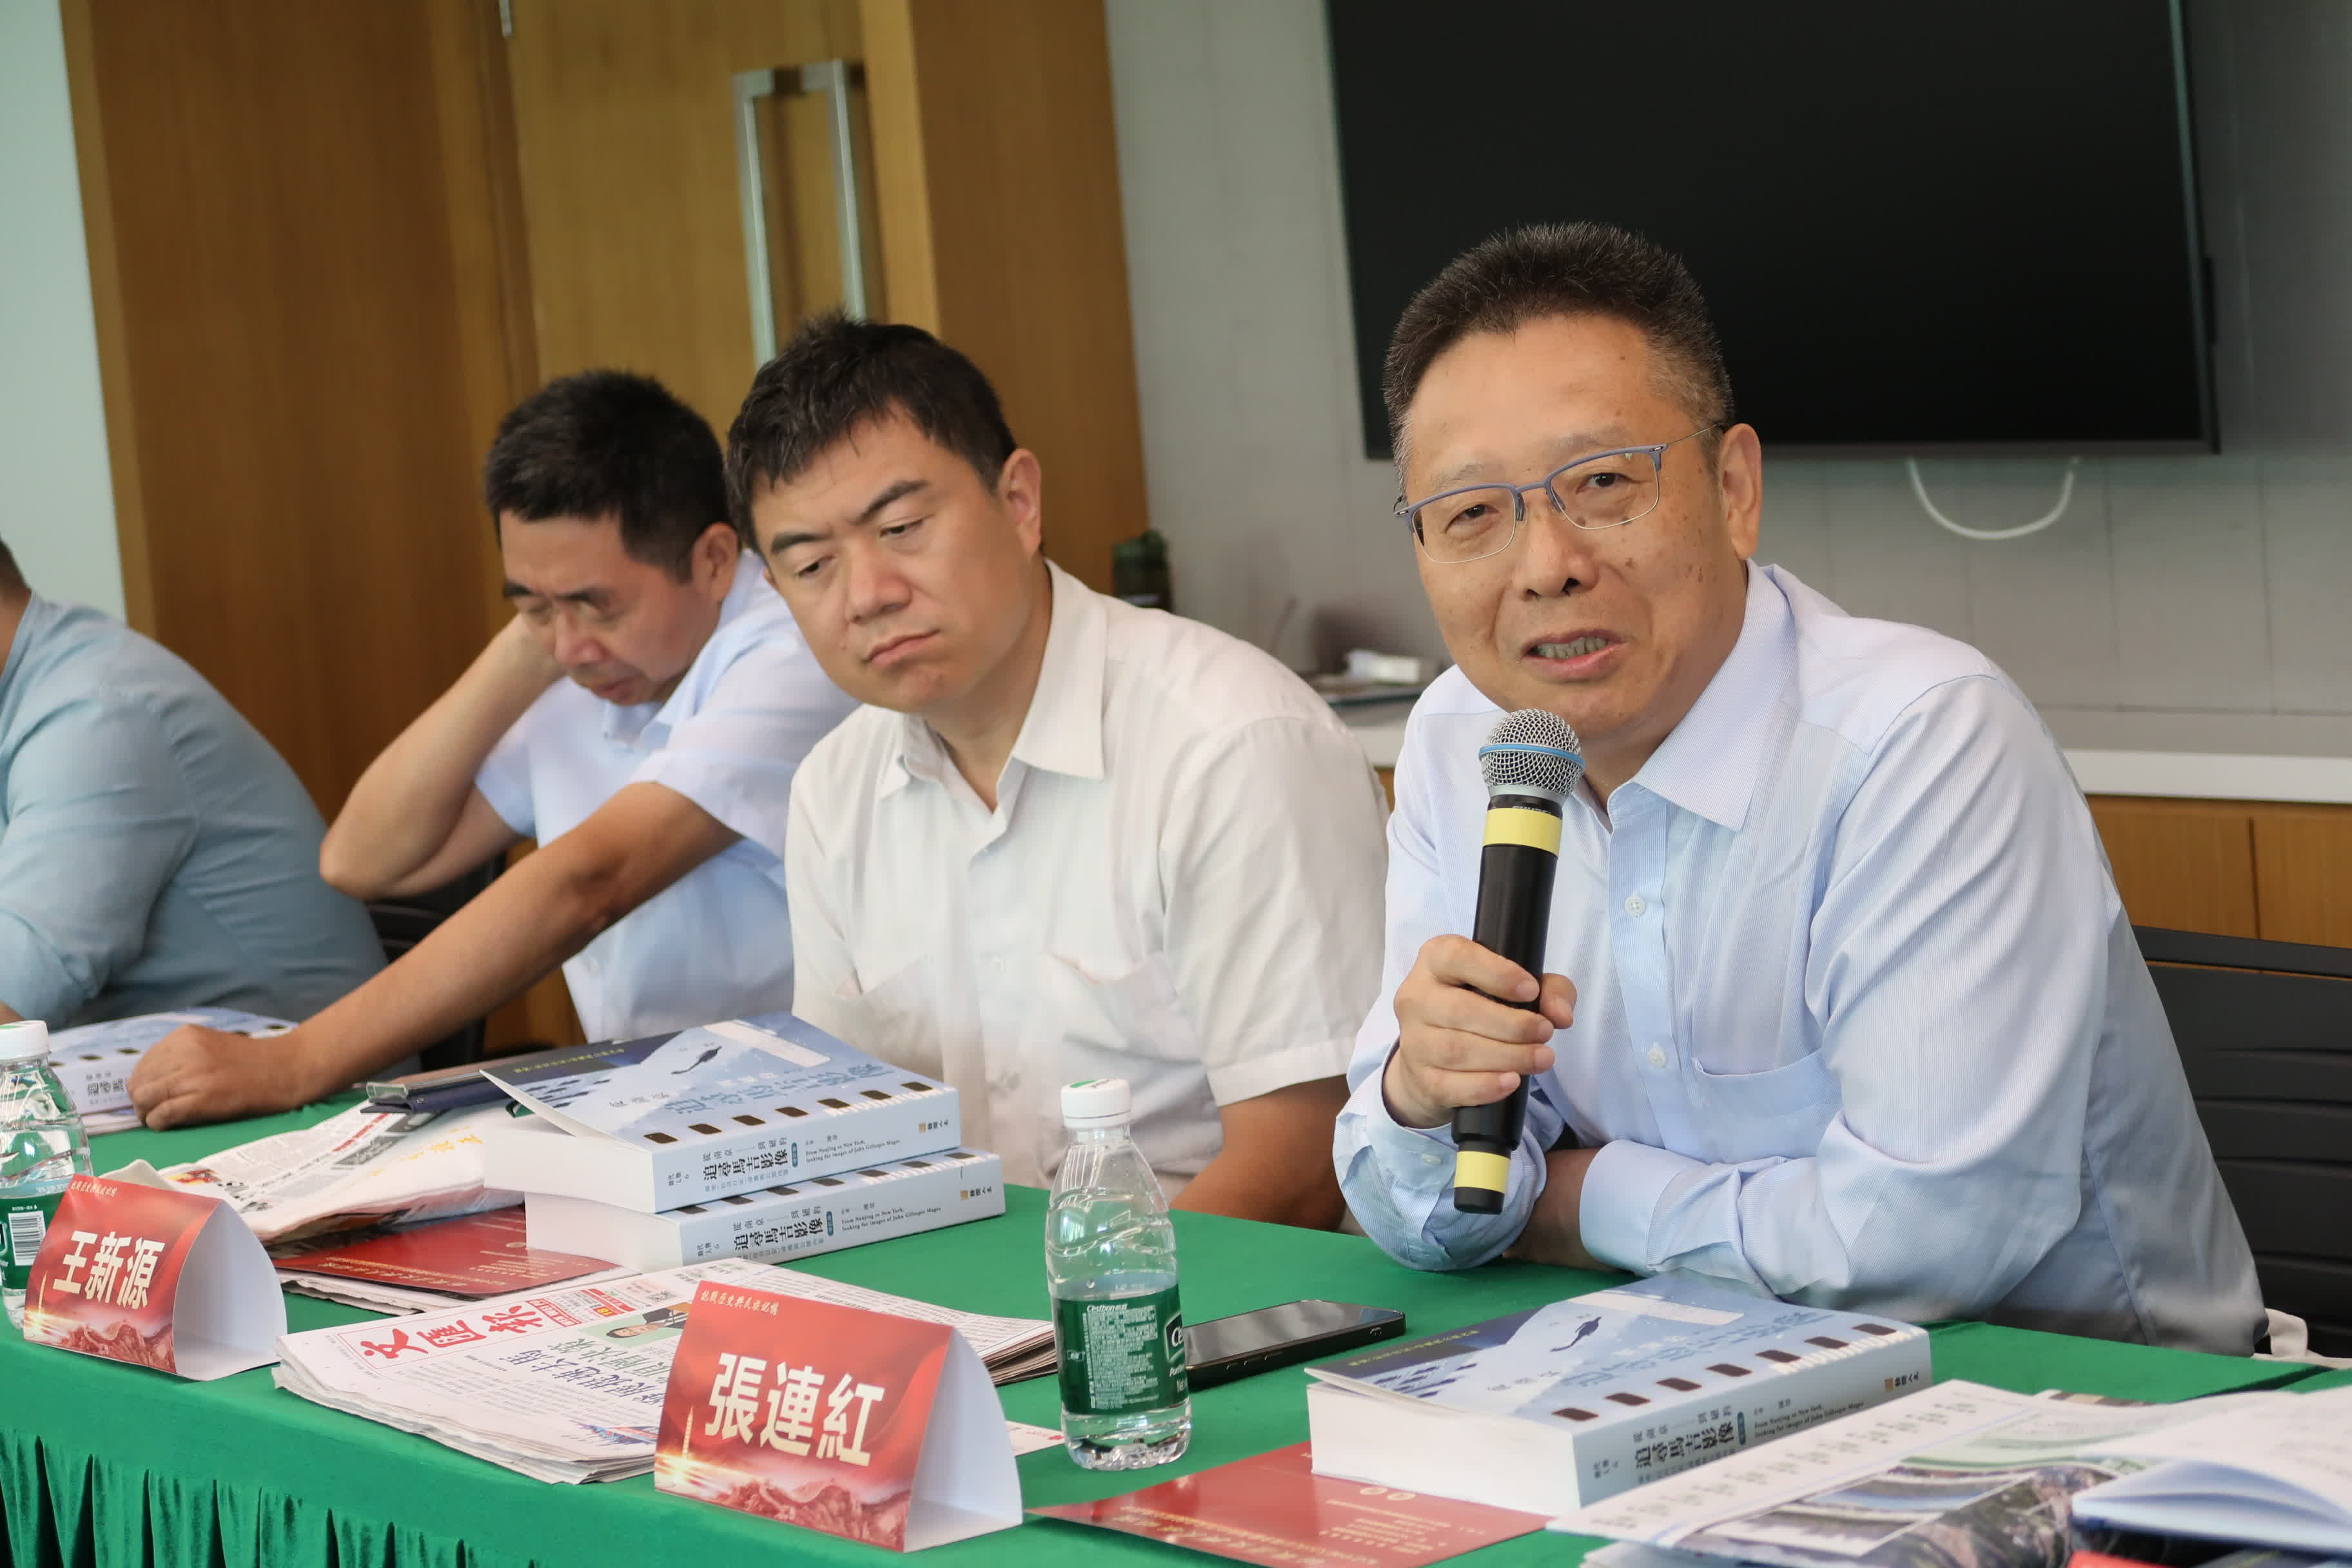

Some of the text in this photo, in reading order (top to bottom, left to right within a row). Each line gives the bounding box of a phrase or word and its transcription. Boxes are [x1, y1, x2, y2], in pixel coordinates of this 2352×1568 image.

[703, 1149, 788, 1181] 追尋馬吉影像
[734, 1218, 824, 1251] 追尋馬吉影像
[53, 1230, 166, 1309] 王新源
[359, 1304, 544, 1359] 文匯報
[703, 1352, 885, 1467] 張連紅
